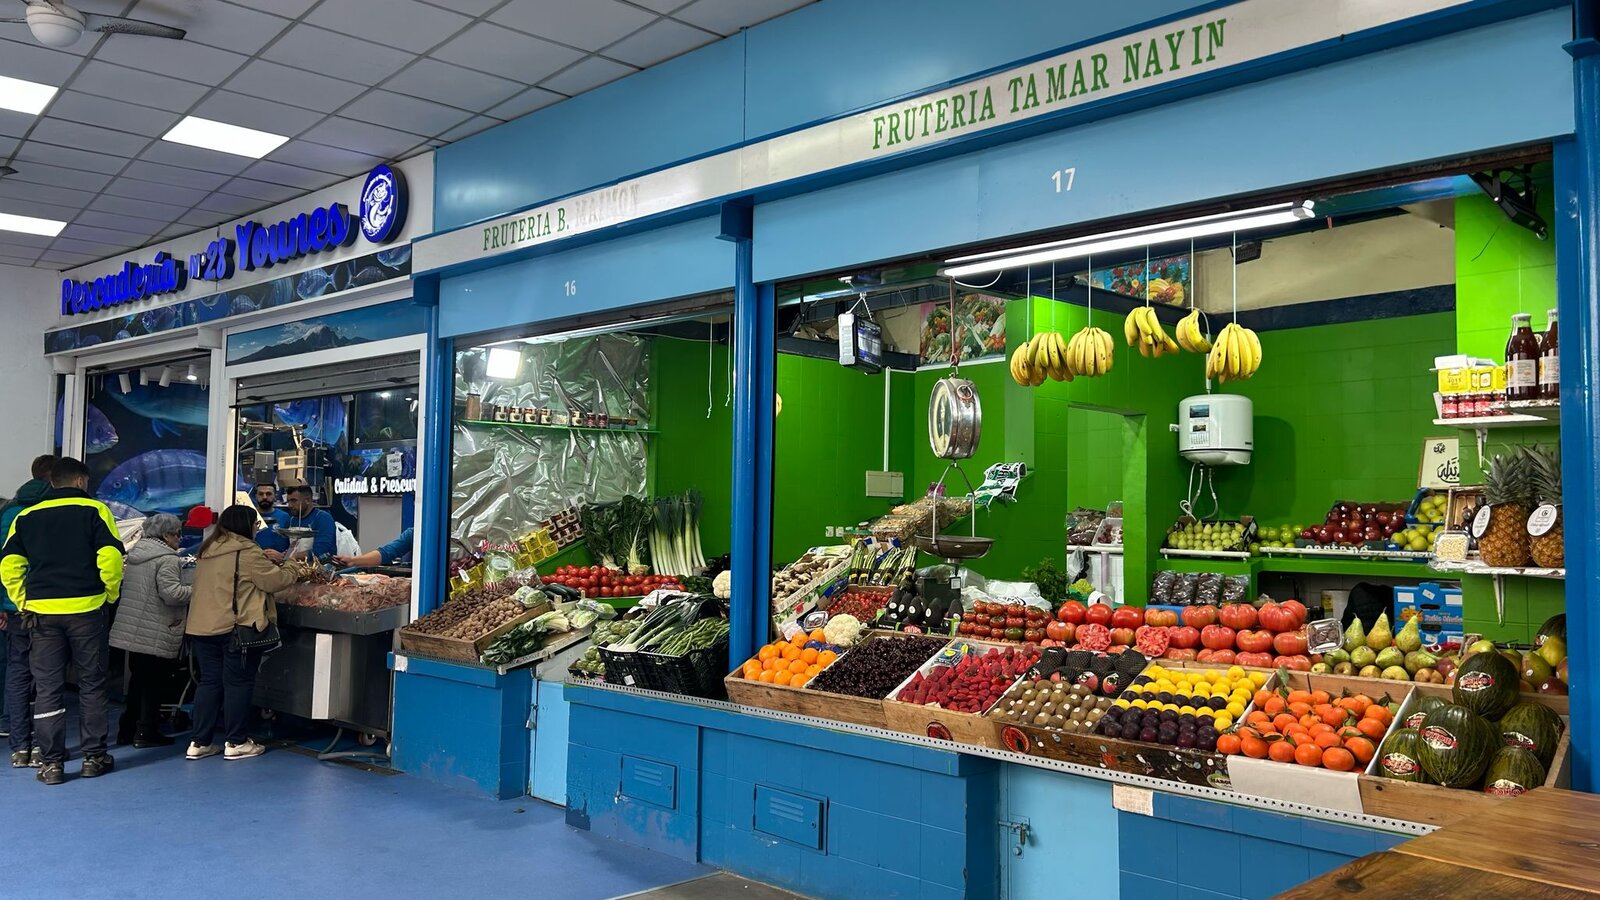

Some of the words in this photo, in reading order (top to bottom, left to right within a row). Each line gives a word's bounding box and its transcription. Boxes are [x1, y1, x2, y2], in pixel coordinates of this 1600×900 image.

[872, 86, 996, 150] FRUTERIA
[1008, 53, 1110, 113] TAMAR
[1122, 18, 1227, 83] NAYIN
[1051, 167, 1076, 193] 17
[483, 211, 551, 251] FRUTERIA
[557, 207, 570, 232] B.
[62, 251, 181, 316] Pescadería
[236, 202, 351, 271] Younes
[564, 280, 577, 297] 16
[334, 477, 368, 494] Calidad
[370, 477, 378, 494] &
